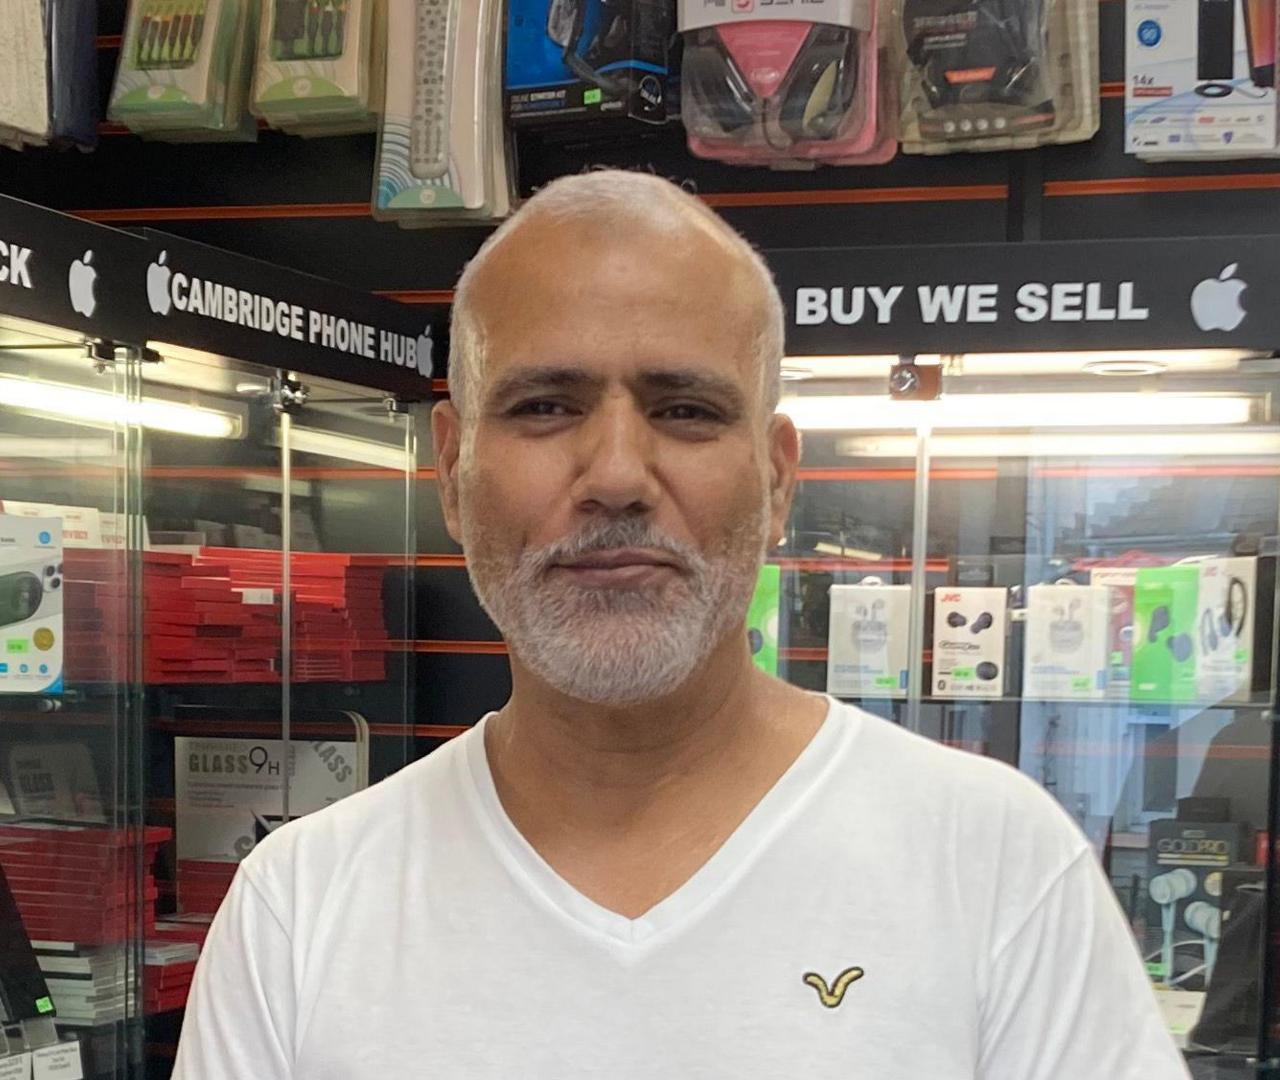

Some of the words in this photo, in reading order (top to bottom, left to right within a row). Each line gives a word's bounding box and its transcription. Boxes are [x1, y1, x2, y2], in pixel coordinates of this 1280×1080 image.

[171, 272, 304, 341] CAMBRIDGE
[308, 310, 376, 359] PHONE
[379, 330, 418, 369] HUB
[796, 285, 903, 325] BUY
[917, 284, 998, 323] WE
[1014, 282, 1149, 322] SELL
[189, 753, 248, 773] GLASS
[249, 745, 280, 776] 9H
